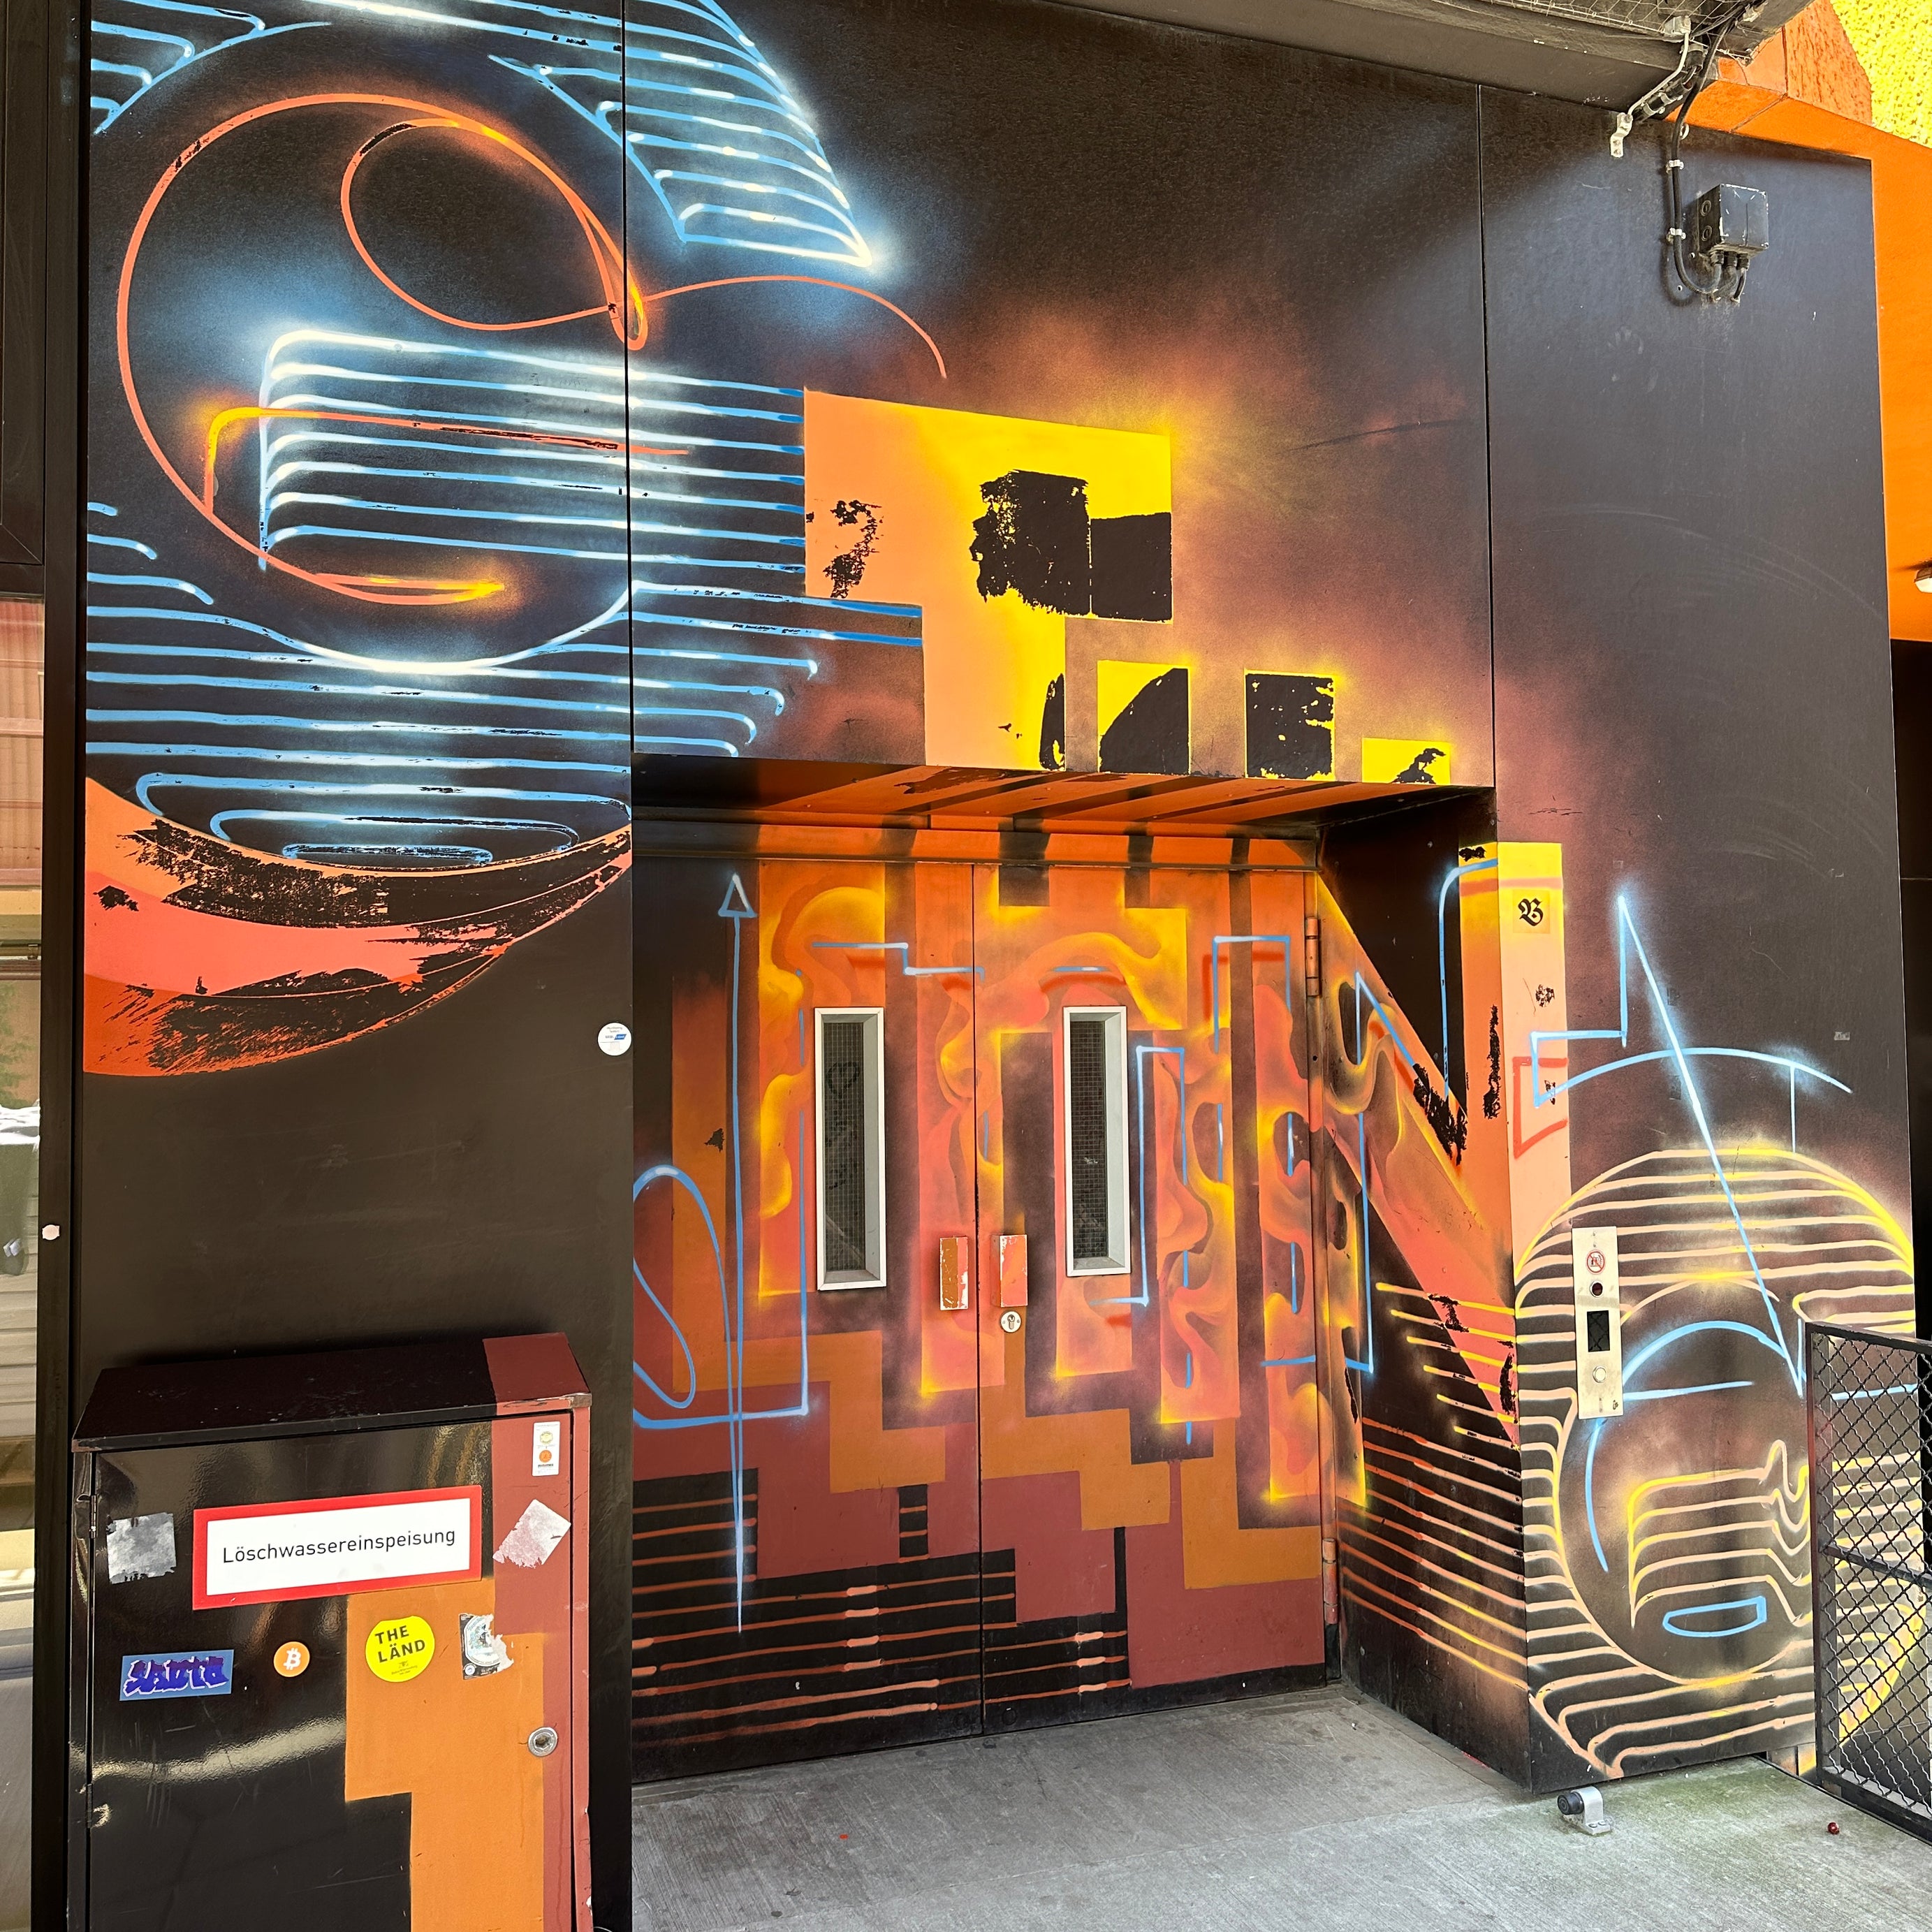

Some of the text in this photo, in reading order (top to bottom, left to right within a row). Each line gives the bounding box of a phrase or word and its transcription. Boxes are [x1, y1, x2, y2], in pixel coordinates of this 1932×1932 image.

[223, 1530, 455, 1564] Löschwassereinspeisung
[374, 1625, 409, 1644] THE
[378, 1639, 425, 1663] LÄND
